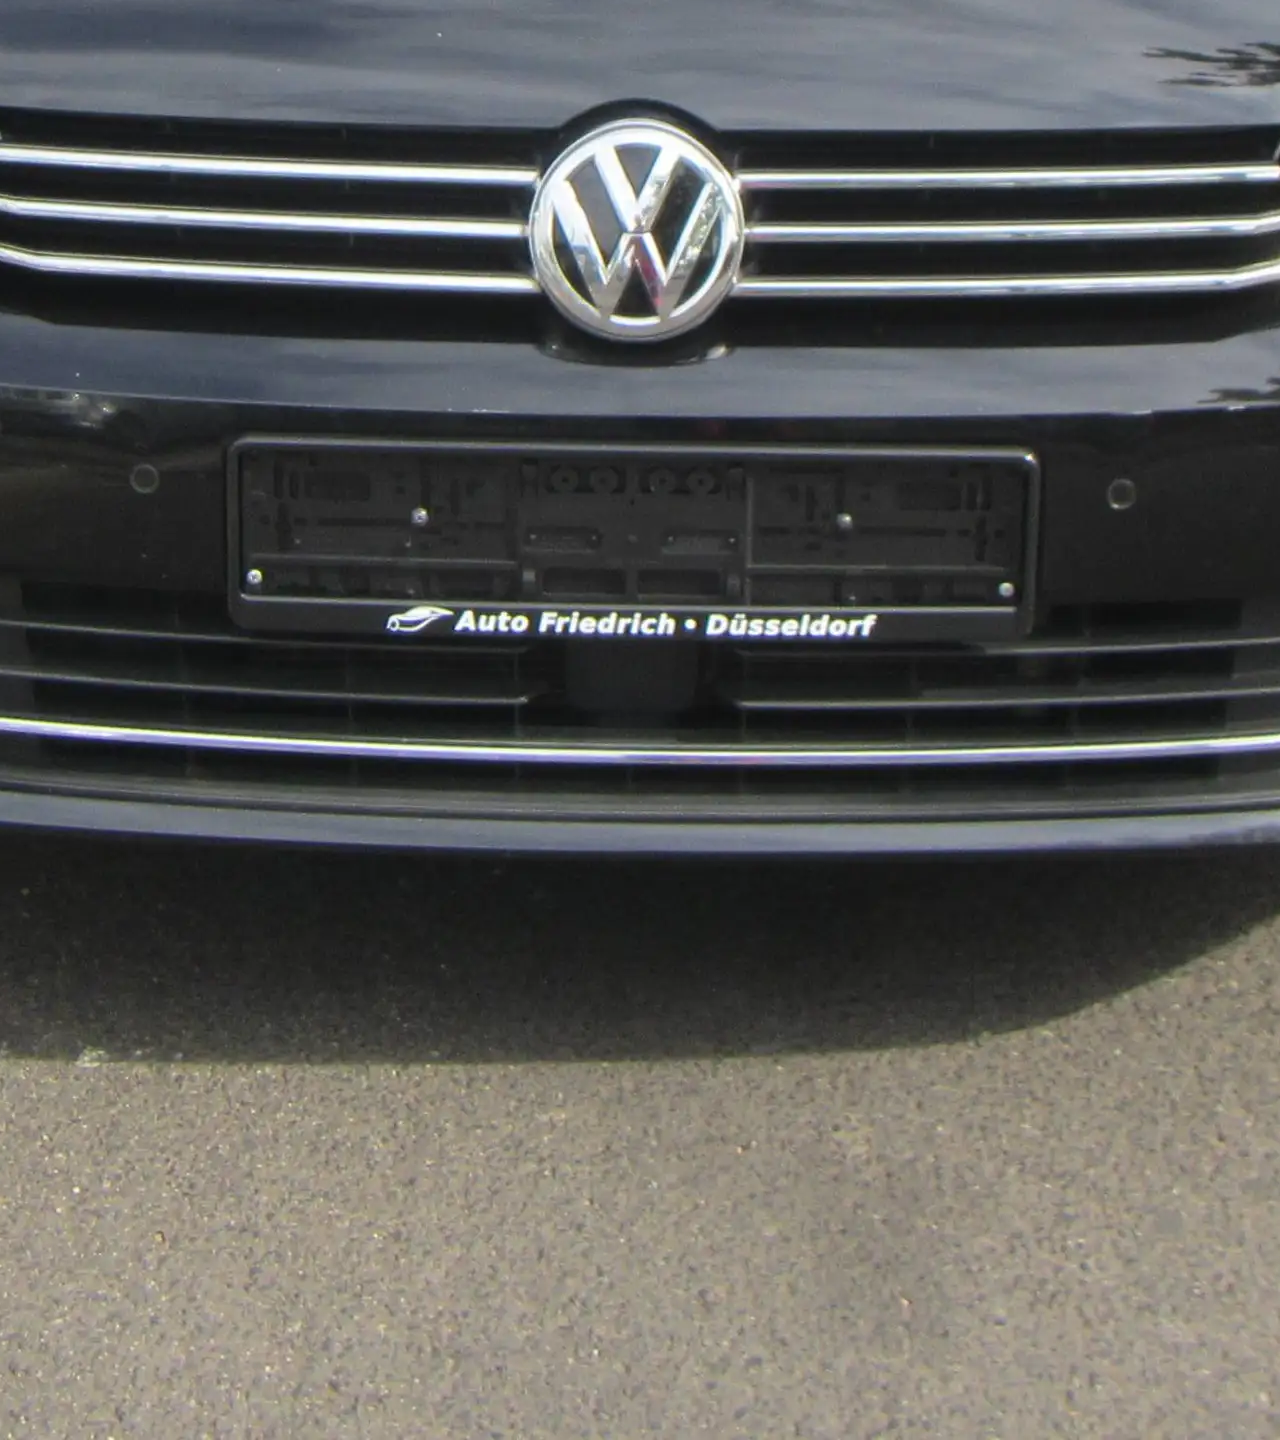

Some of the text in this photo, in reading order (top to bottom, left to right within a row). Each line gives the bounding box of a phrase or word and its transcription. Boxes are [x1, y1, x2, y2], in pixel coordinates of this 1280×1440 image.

[454, 610, 878, 637] Auto Friedrich Düsseldorf
